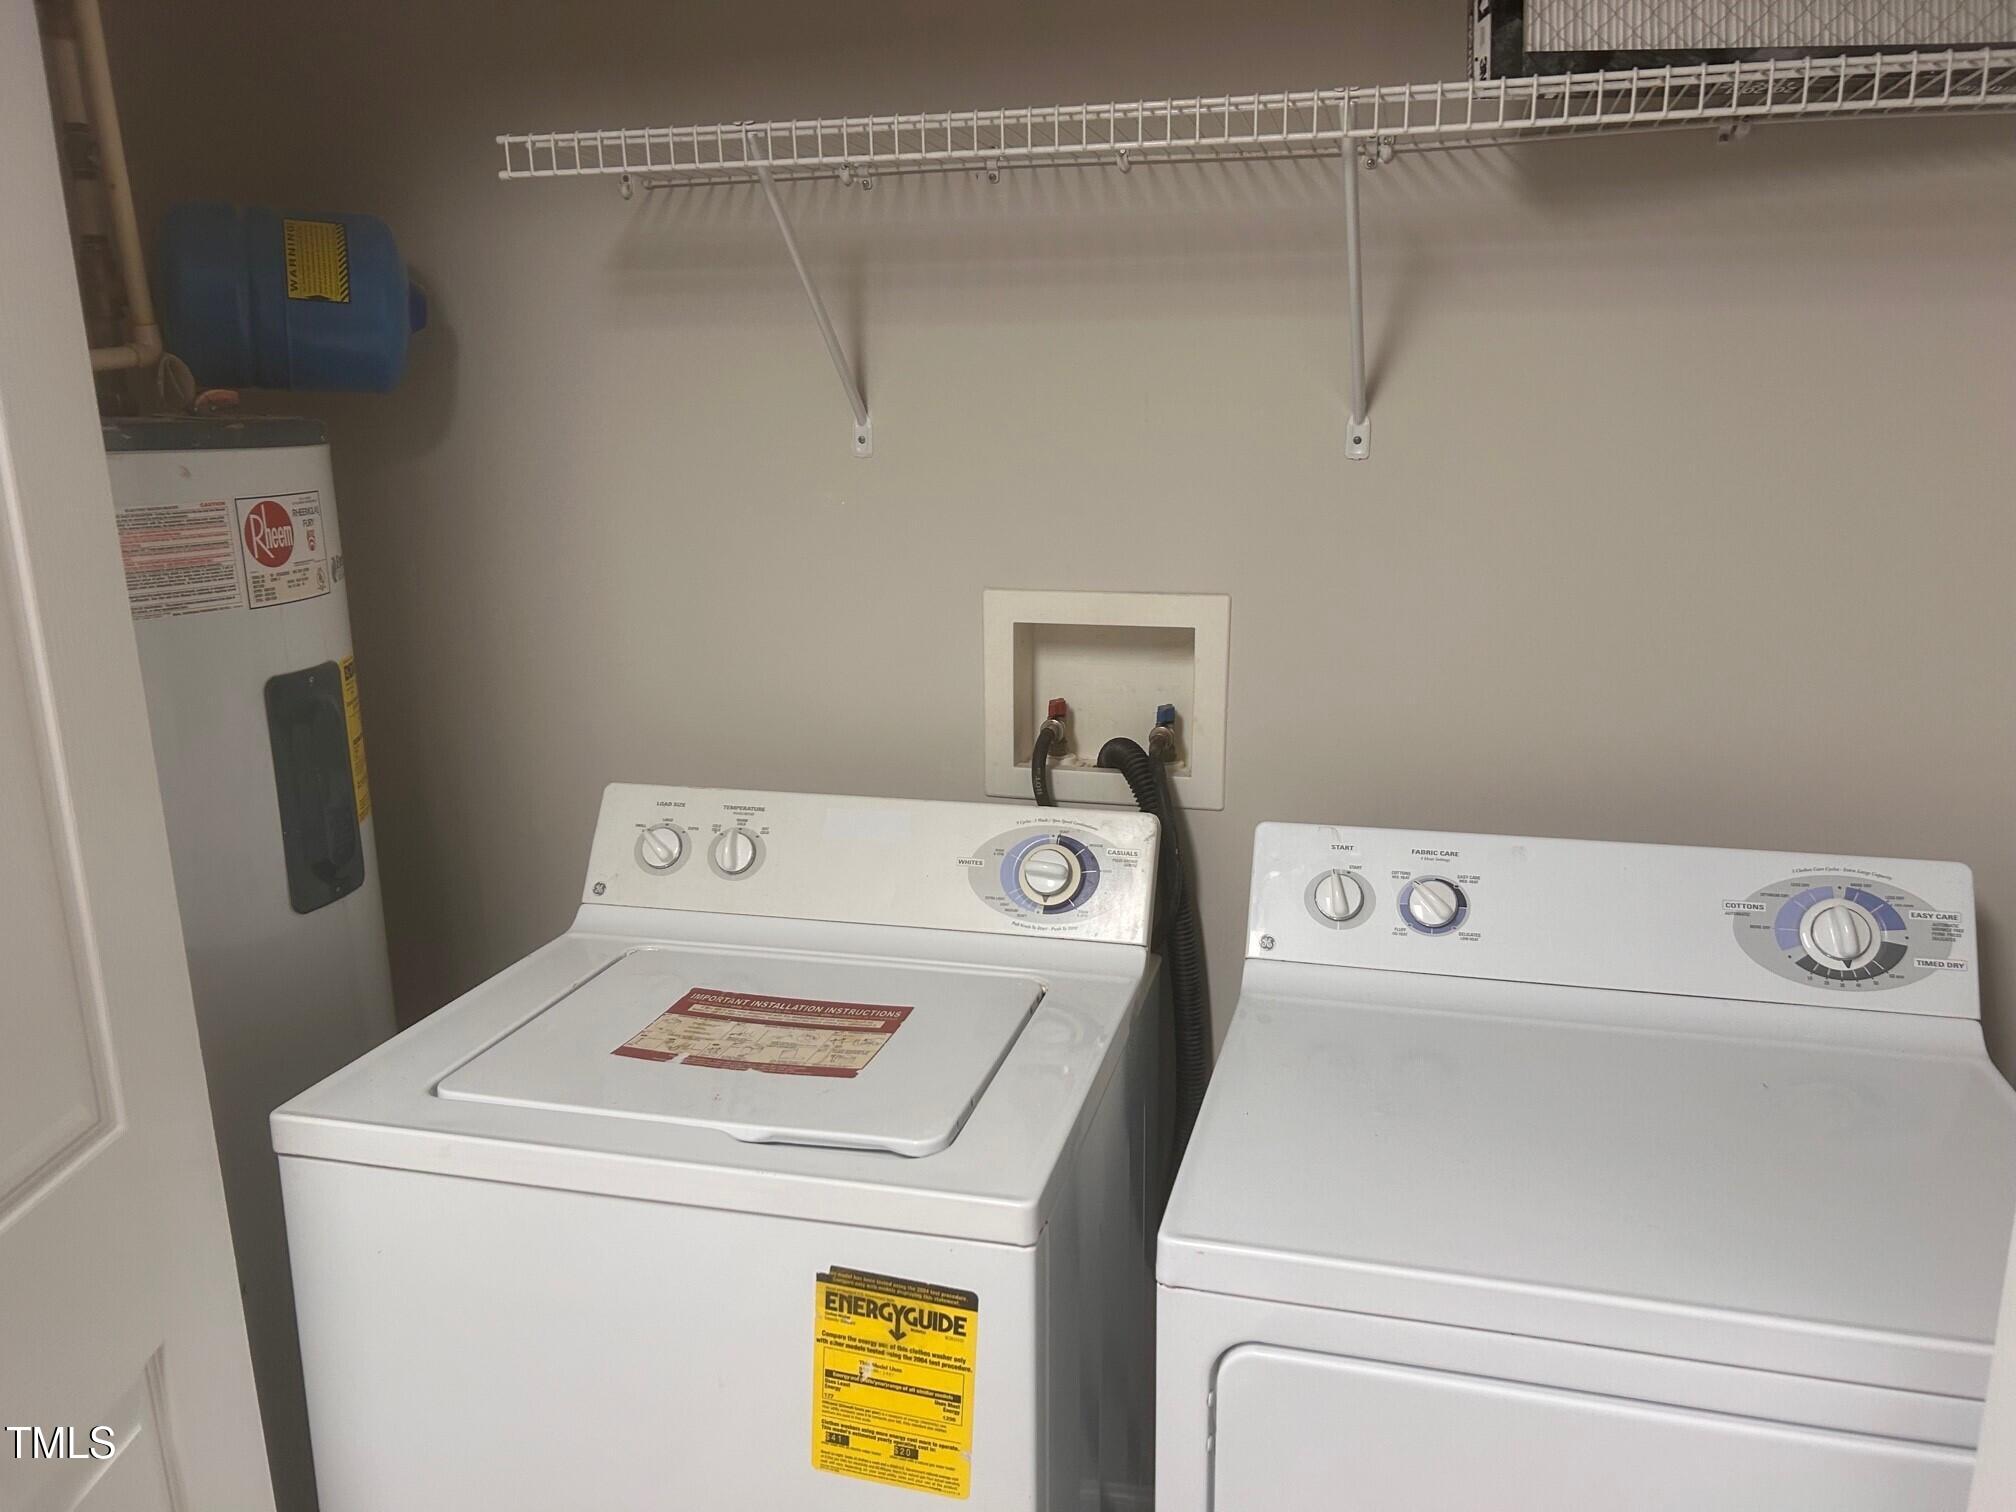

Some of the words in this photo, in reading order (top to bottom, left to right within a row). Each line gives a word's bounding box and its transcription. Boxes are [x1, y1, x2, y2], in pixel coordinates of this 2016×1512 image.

[286, 222, 298, 292] WARNING
[249, 504, 293, 559] Rheem
[1725, 902, 1764, 910] COTTONS
[1917, 960, 1944, 968] TIMED
[1947, 961, 1965, 969] DRY
[690, 993, 751, 1006] IMPORTANT
[750, 1000, 823, 1013] INSTALLATION
[824, 1006, 901, 1019] INSTRUCTIONS
[825, 1291, 967, 1338] ENERGYGUIDE
[816, 1337, 827, 1345] with
[845, 1342, 864, 1352] models
[866, 1346, 883, 1356] tested
[902, 1353, 911, 1361] the
[913, 1355, 927, 1364] 2004
[929, 1358, 939, 1366] test
[941, 1360, 972, 1373] procedure.
[821, 1330, 845, 1342] Compare
[848, 1335, 856, 1343] the
[858, 1337, 876, 1347] energy
[897, 1344, 907, 1352] this
[909, 1347, 930, 1357] clothes
[931, 1351, 951, 1361] washer
[954, 1355, 965, 1364] only
[821, 1419, 839, 1427] Clothes
[841, 1422, 859, 1431] washers
[861, 1426, 873, 1435] using
[889, 1432, 904, 1441] energy
